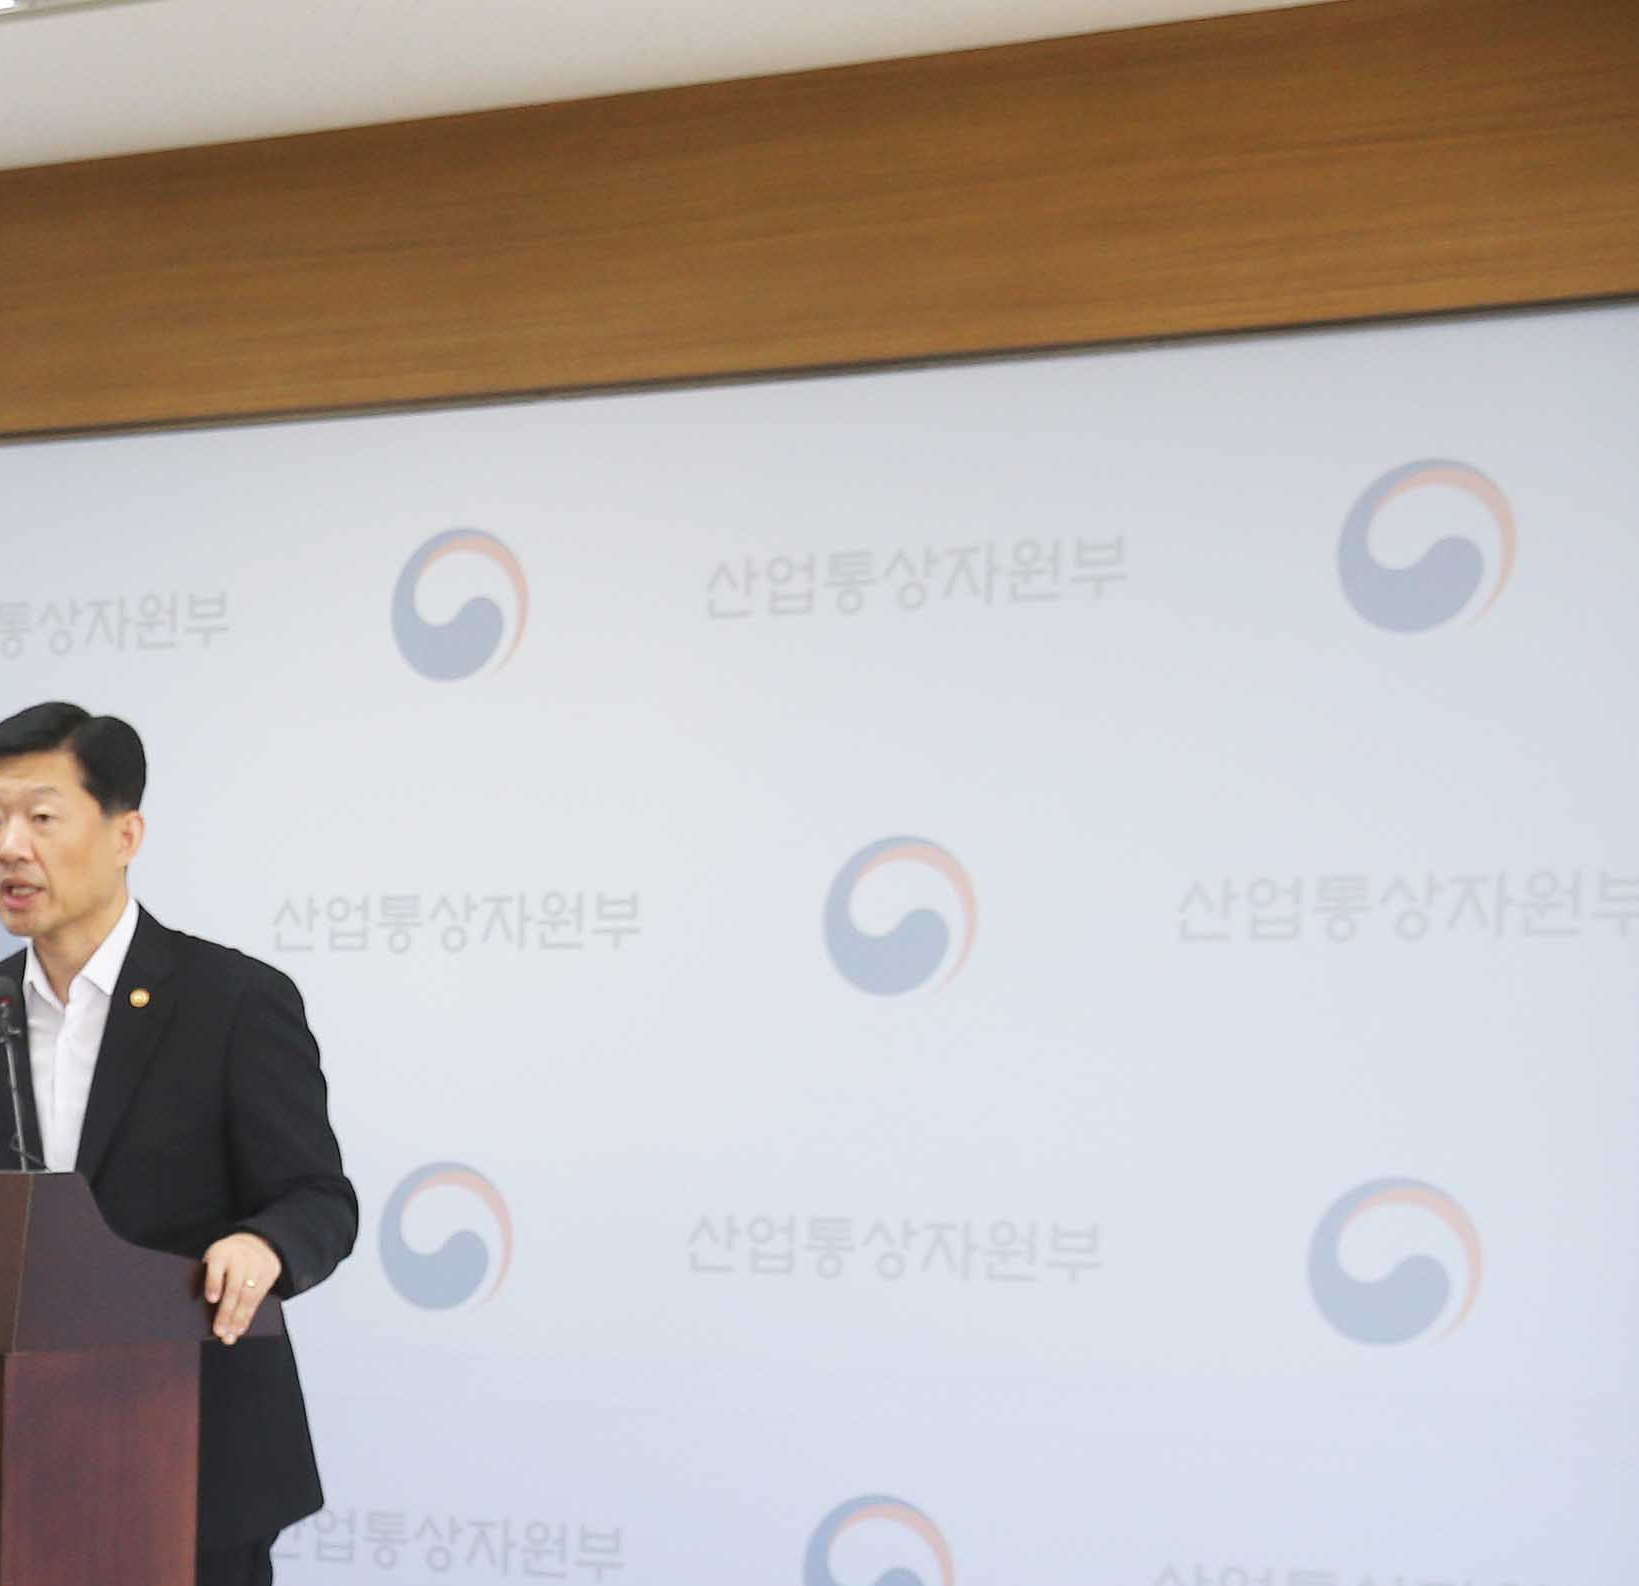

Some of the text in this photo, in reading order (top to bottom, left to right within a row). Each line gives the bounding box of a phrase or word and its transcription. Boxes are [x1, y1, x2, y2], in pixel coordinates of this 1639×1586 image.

[706, 535, 1127, 619] 산업통상자원부
[272, 890, 642, 953] 산업통상자원부
[686, 1212, 1103, 1285] 산업통상자원부
